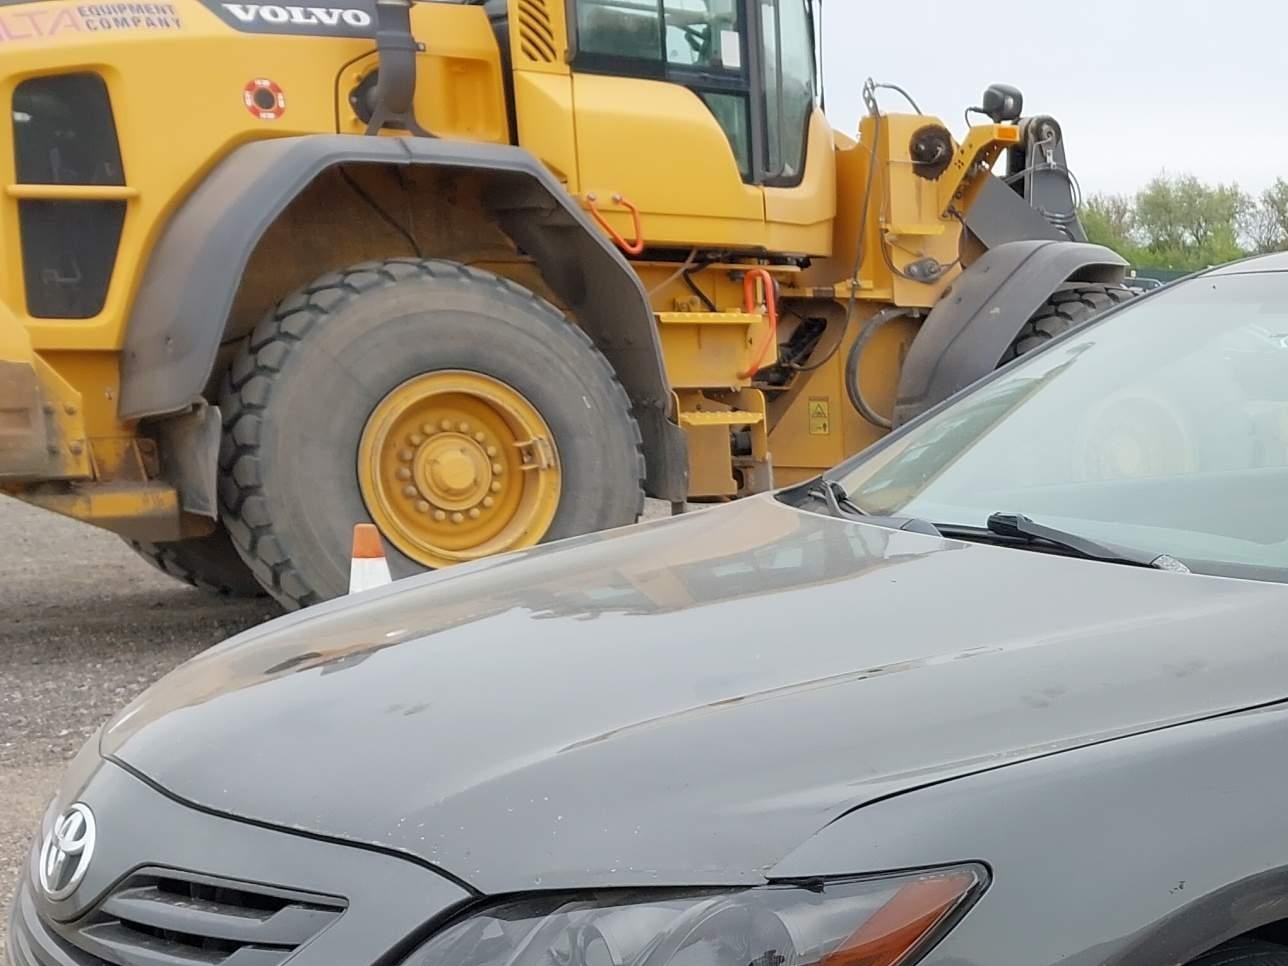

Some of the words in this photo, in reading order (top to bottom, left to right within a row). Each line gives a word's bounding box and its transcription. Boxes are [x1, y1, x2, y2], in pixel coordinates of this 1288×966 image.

[77, 3, 176, 17] EQUIPMENT
[221, 3, 371, 26] VOLVO
[86, 16, 182, 31] COMPANY
